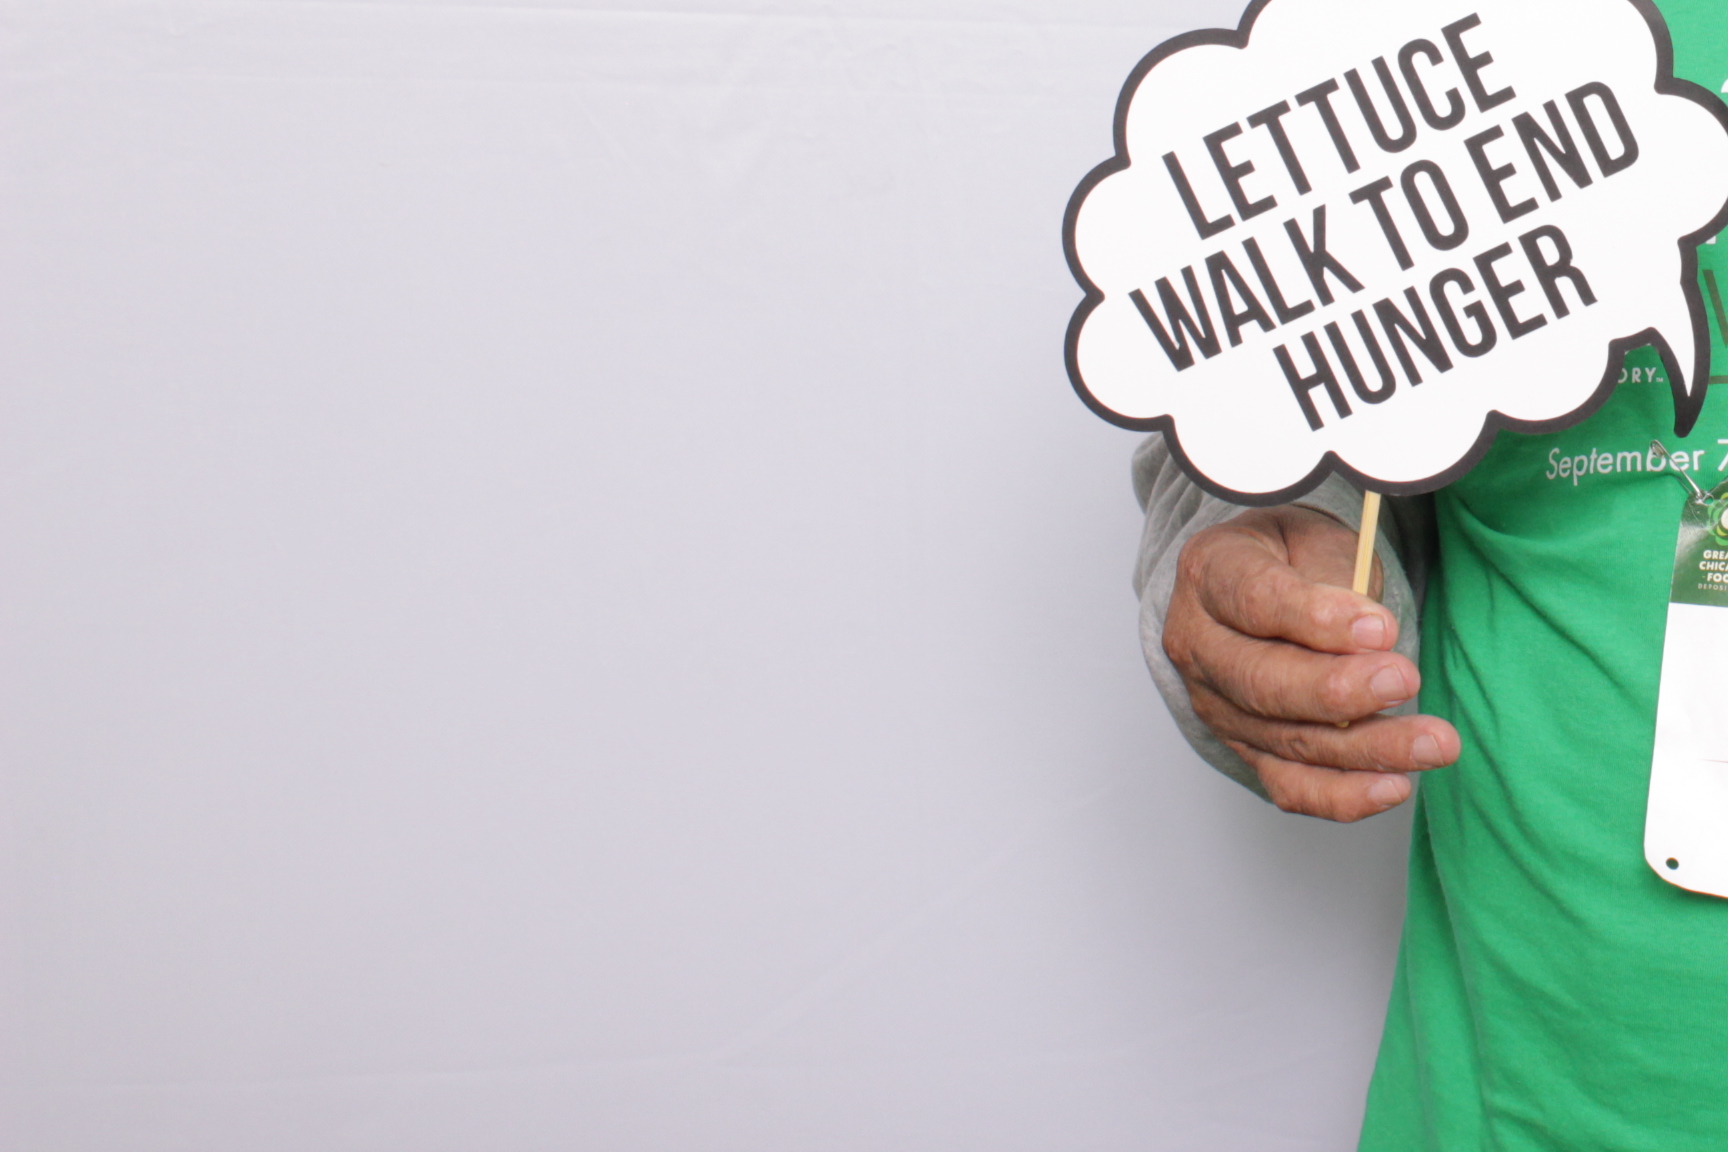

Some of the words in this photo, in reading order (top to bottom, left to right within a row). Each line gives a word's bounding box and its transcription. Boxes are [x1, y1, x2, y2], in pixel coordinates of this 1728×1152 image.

[1128, 203, 1365, 372] WALK
[1349, 159, 1470, 271] TO
[1463, 81, 1640, 224] END
[1161, 12, 1516, 240] LETTUCE
[1273, 224, 1598, 432] HUNGER
[1546, 444, 1706, 486] September
